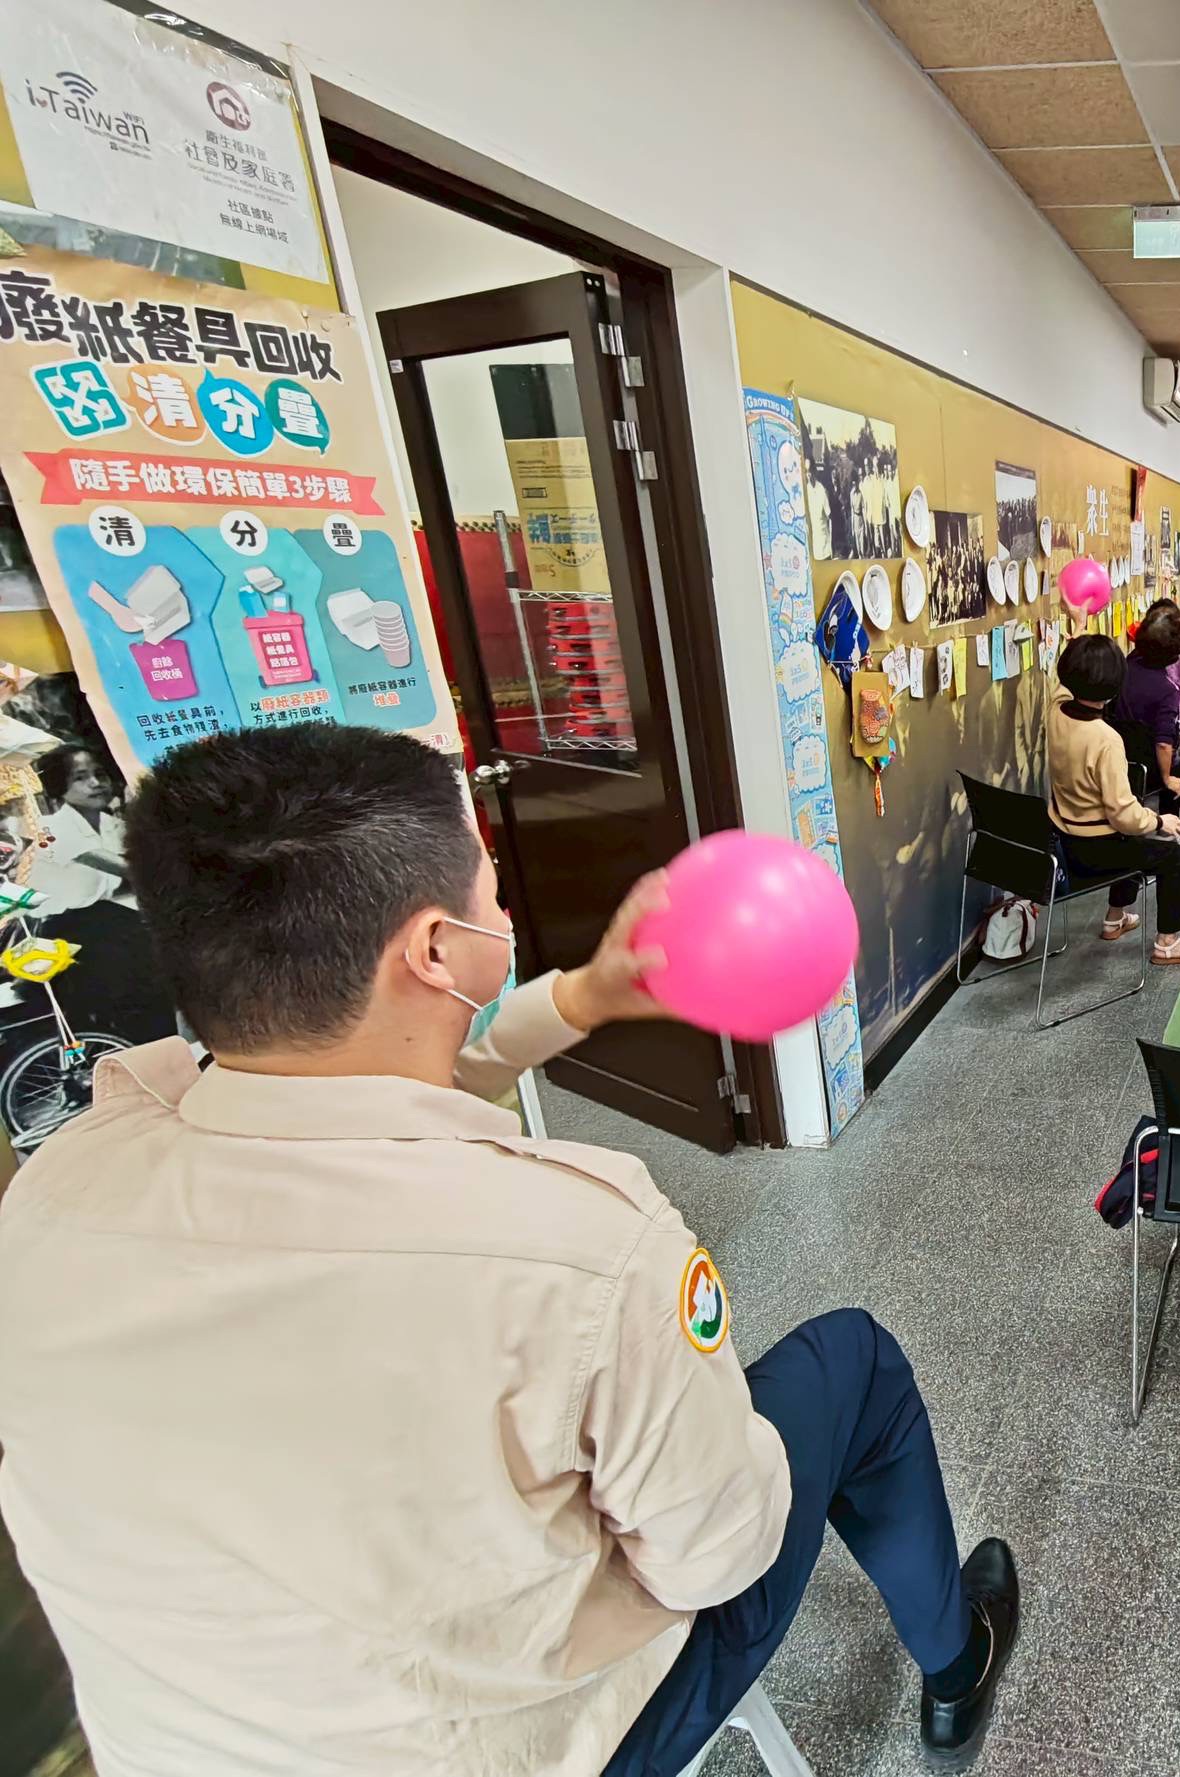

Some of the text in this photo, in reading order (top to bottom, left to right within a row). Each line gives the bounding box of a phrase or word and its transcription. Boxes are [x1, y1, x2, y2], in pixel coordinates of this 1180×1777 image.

[184, 138, 296, 193] 社會及家庭署
[227, 199, 275, 225] 社區據點
[0, 270, 342, 382] 廢紙餐具回收
[70, 458, 354, 504] 隨手做環保簡單3步驟
[99, 515, 133, 548] 清
[231, 520, 259, 548] 分
[331, 522, 357, 549] 疊
[150, 668, 184, 682] 回收桶
[348, 676, 417, 696] 將廢紙容器進行
